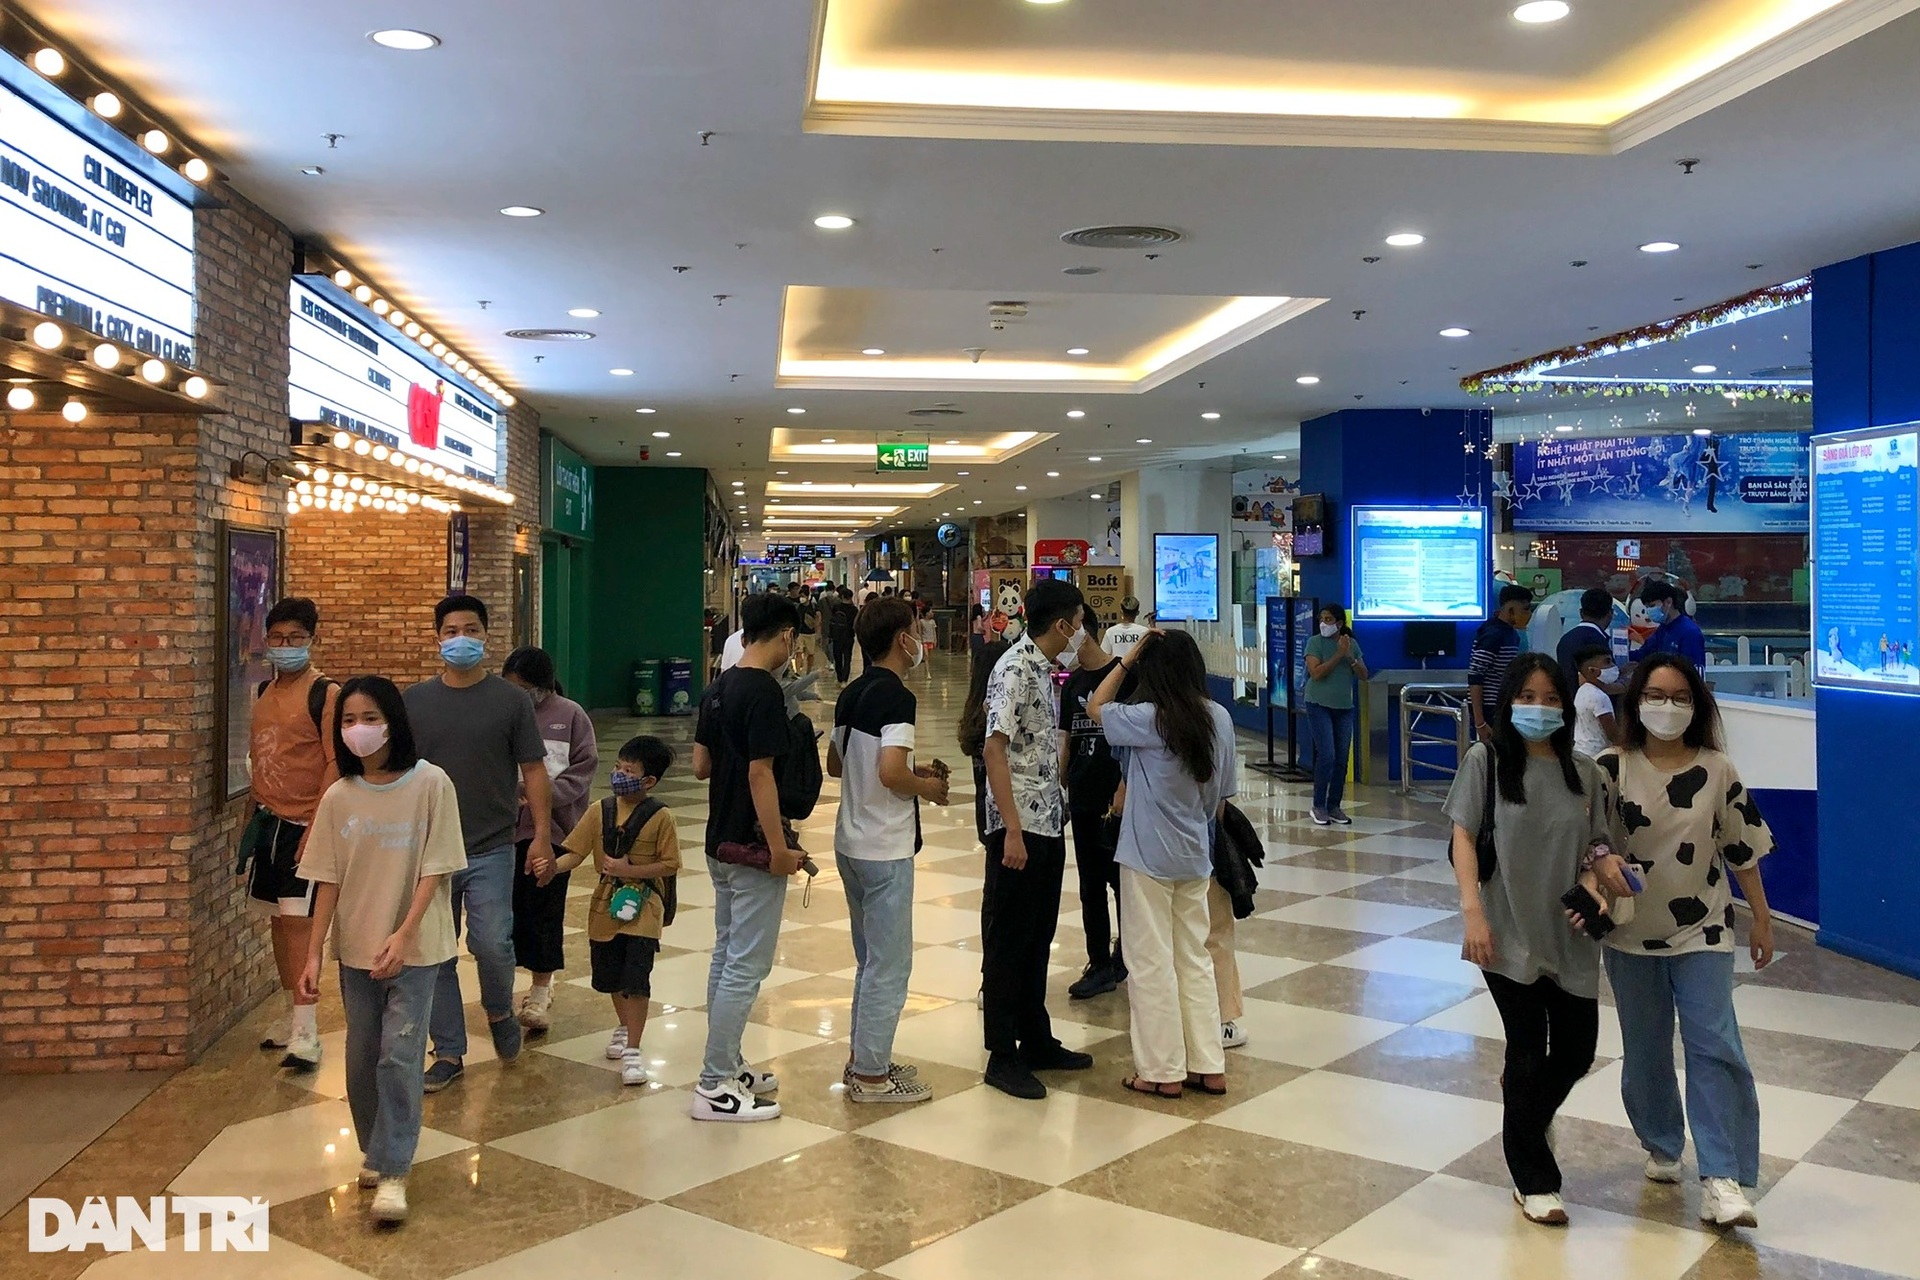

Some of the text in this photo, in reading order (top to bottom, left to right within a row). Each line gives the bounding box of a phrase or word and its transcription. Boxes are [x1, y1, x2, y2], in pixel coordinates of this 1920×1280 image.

[0, 155, 126, 248] NOW SHOWING AT CGV
[94, 310, 104, 337] &
[907, 449, 928, 462] EXIT
[1537, 443, 1562, 457] NGHỆ
[1564, 440, 1593, 453] THUẬT
[1537, 458, 1546, 469] ÍT
[1573, 451, 1593, 465] MỘT
[1087, 573, 1118, 587] Boft
[1114, 633, 1139, 644] DIOR
[1223, 1027, 1233, 1039] N
